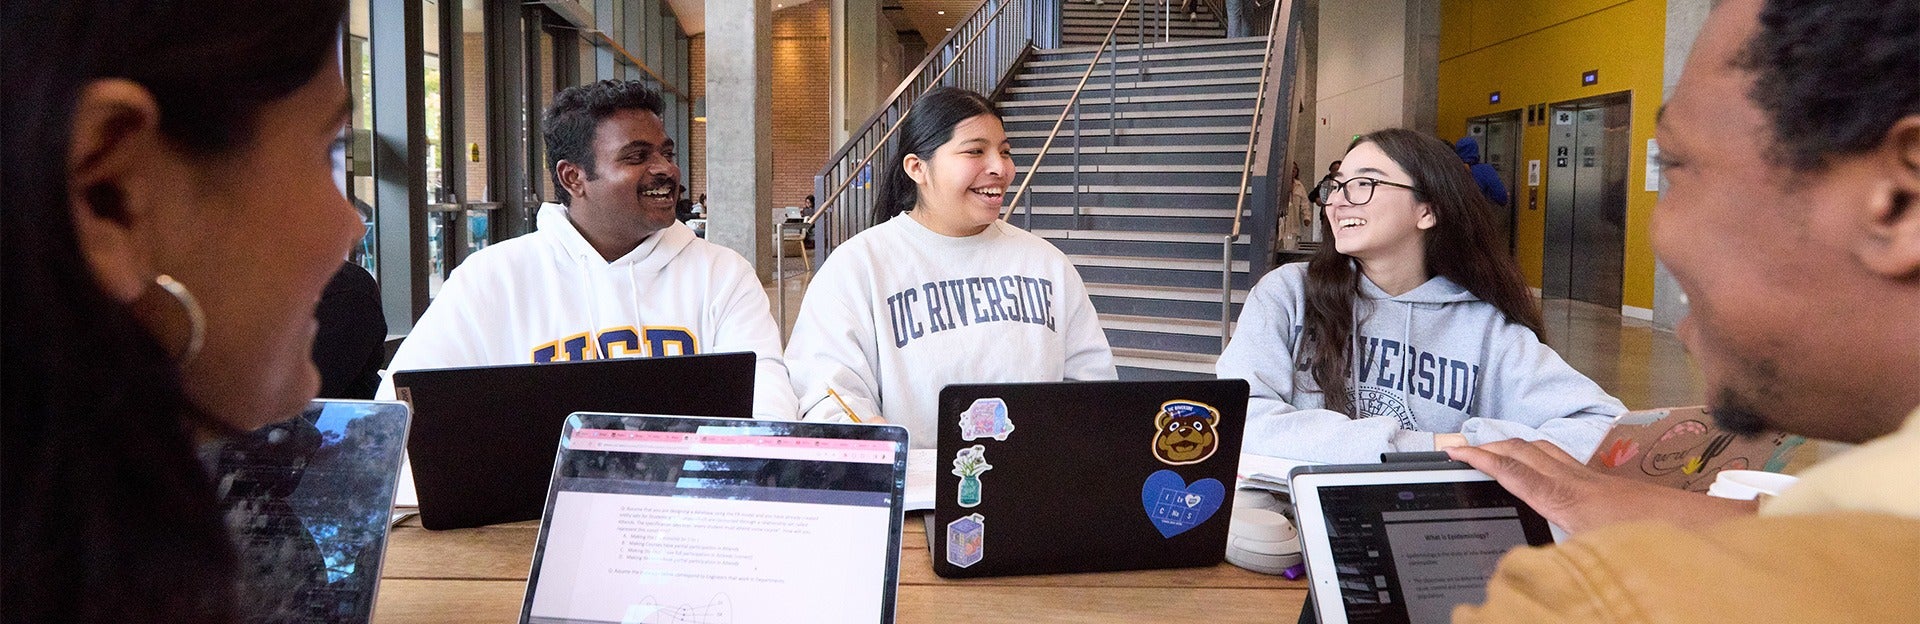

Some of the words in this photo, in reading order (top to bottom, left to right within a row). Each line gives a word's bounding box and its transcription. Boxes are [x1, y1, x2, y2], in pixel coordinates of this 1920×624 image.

[887, 287, 924, 349] UC
[922, 275, 1057, 334] RIVERSIDE
[1368, 392, 1385, 402] OF
[1160, 507, 1165, 515] C
[1186, 512, 1192, 520] S
